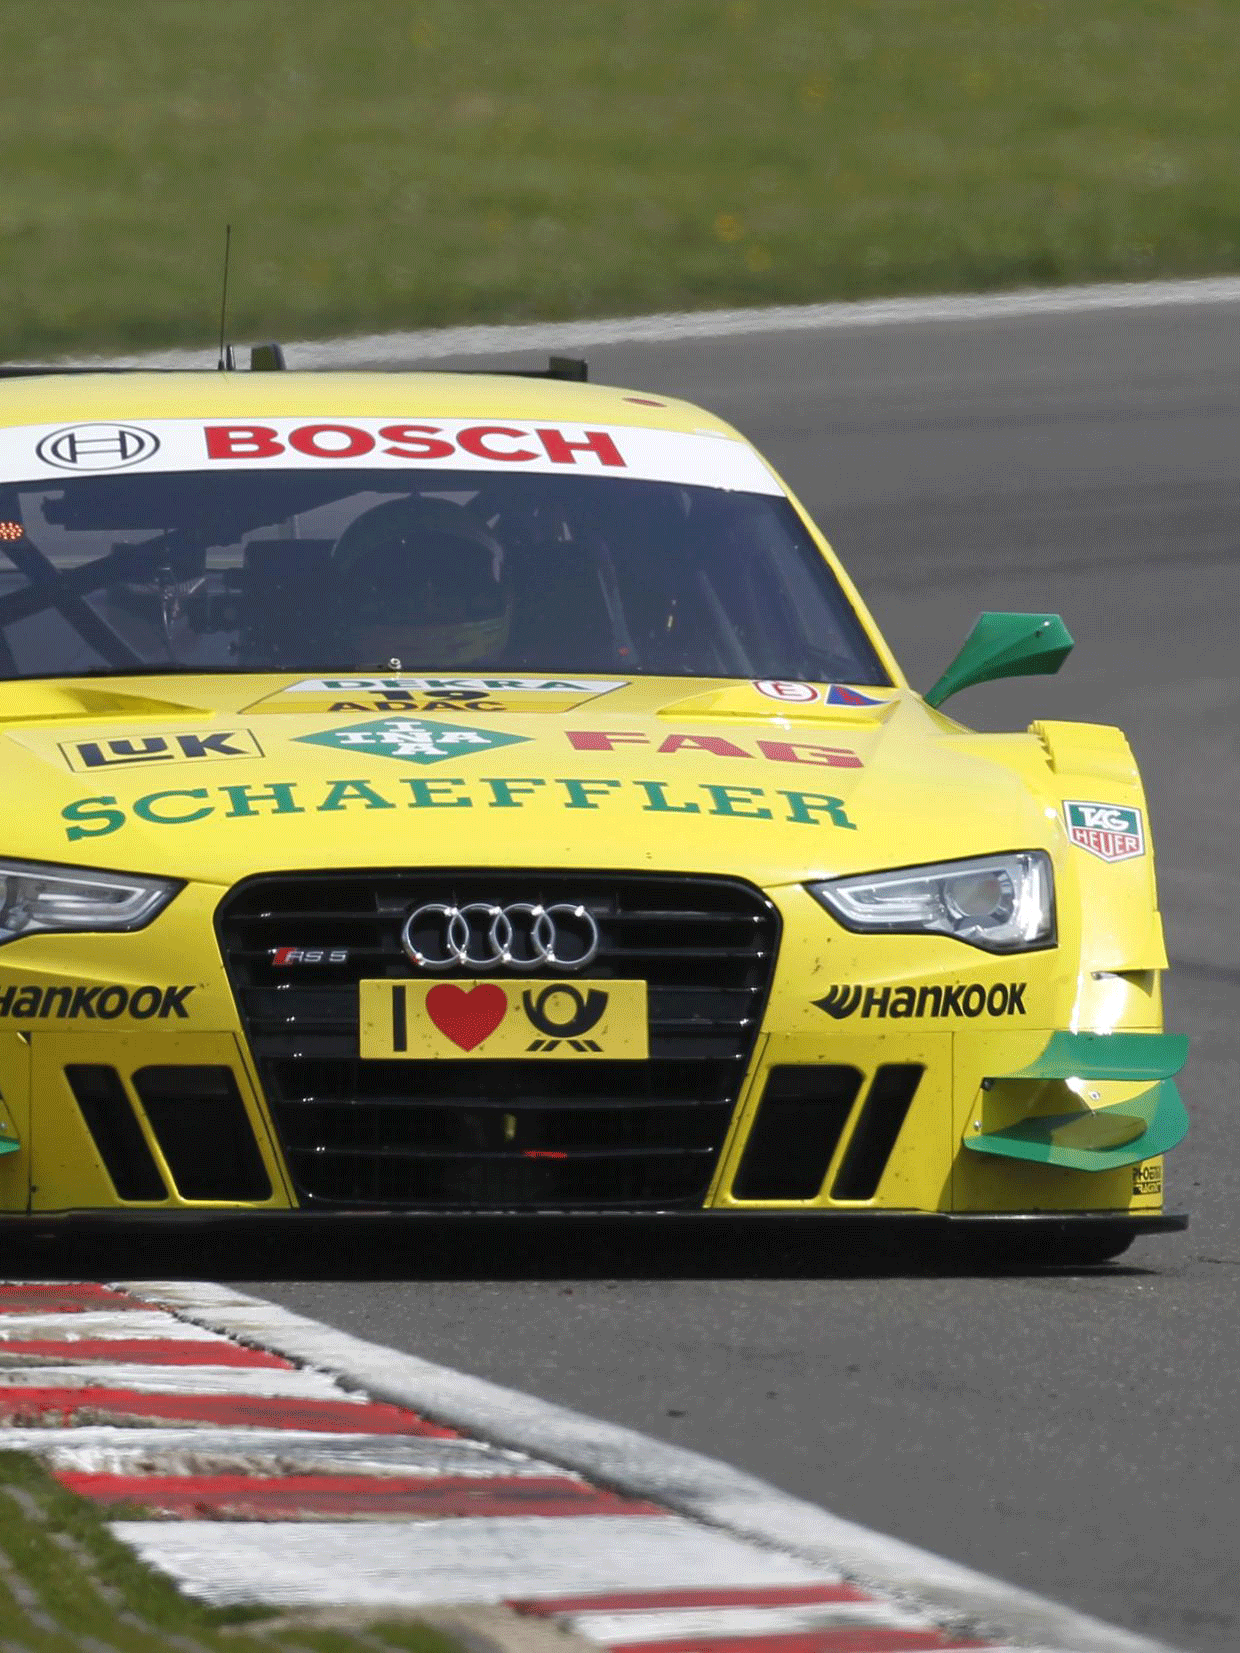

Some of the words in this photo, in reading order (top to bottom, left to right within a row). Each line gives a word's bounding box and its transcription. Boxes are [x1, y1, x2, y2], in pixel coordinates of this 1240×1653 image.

[203, 424, 628, 467] BOSCH
[323, 680, 590, 689] DEKRA
[368, 690, 490, 701] 19
[326, 701, 507, 713] ADAC
[334, 731, 492, 744] INA
[566, 730, 864, 768] FAG
[60, 777, 858, 843] SCHAEFFLER
[1078, 807, 1129, 832] TAG
[1075, 829, 1138, 856] HEUER
